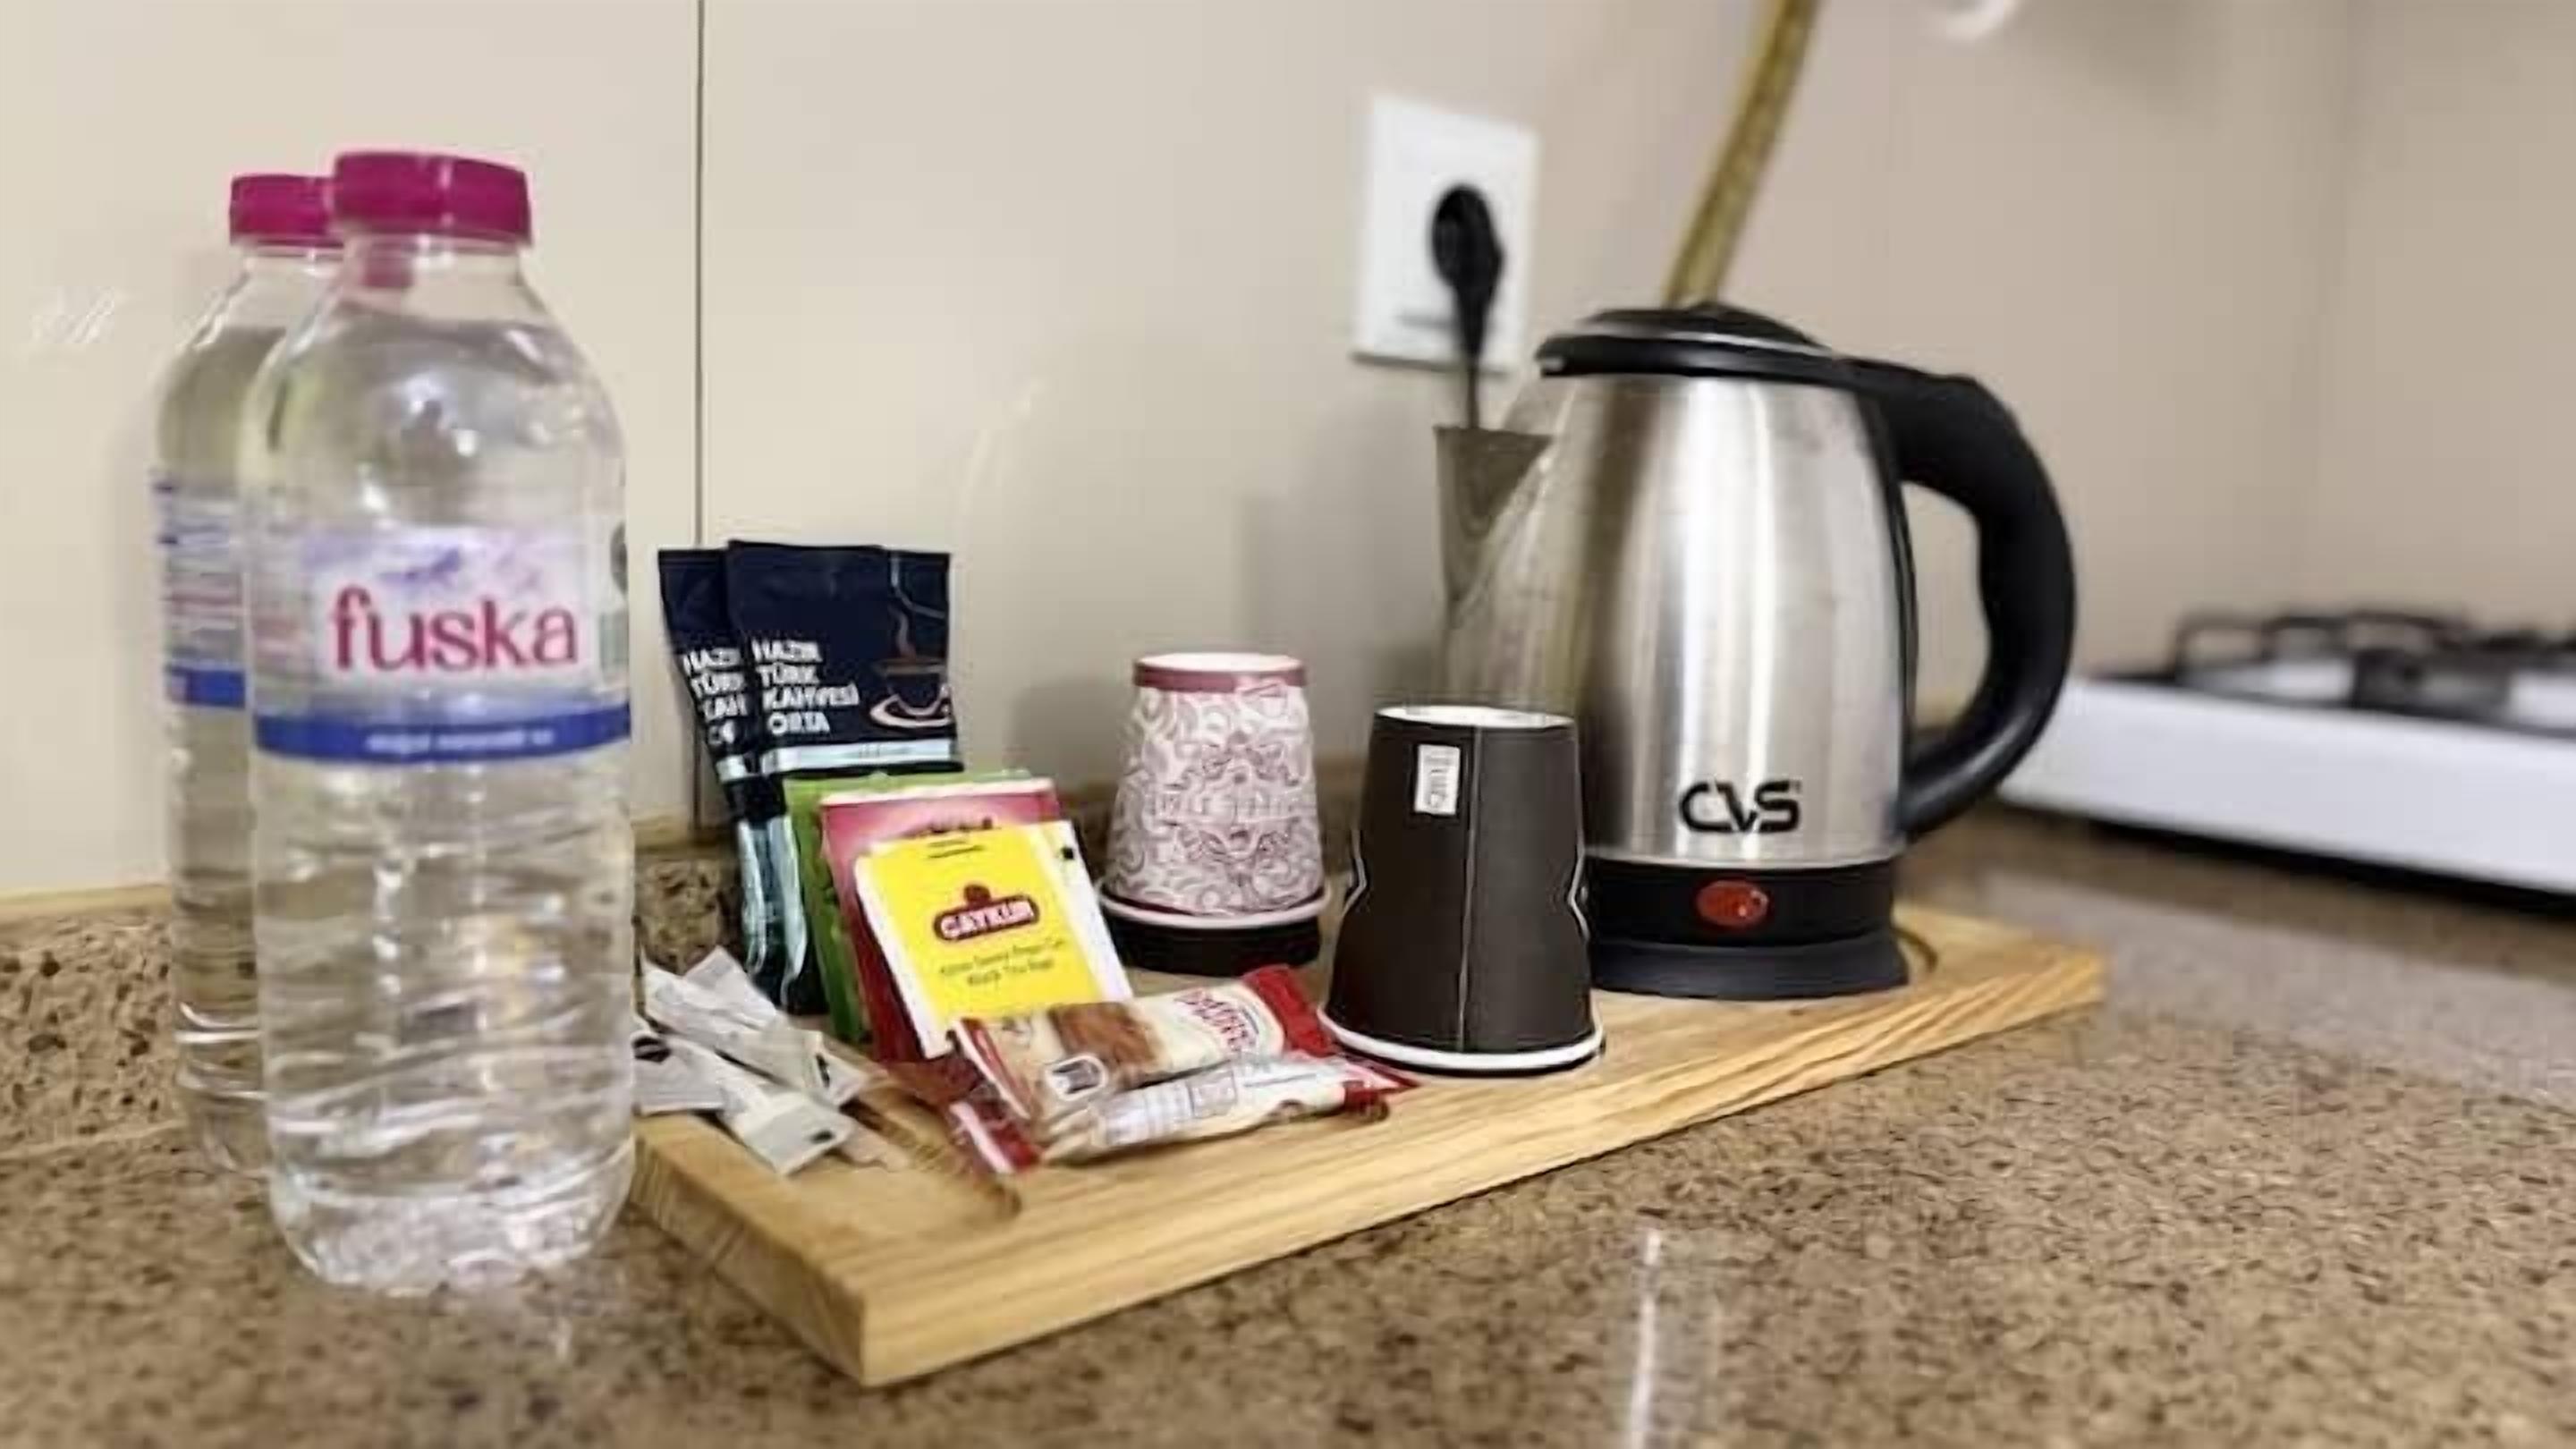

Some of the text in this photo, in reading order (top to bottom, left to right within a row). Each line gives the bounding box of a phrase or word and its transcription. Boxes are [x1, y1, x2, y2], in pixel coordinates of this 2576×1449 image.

[331, 584, 578, 670] fuska
[756, 662, 820, 688] TÜRK
[767, 712, 831, 736] ORTA
[1678, 780, 1801, 834] CVS
